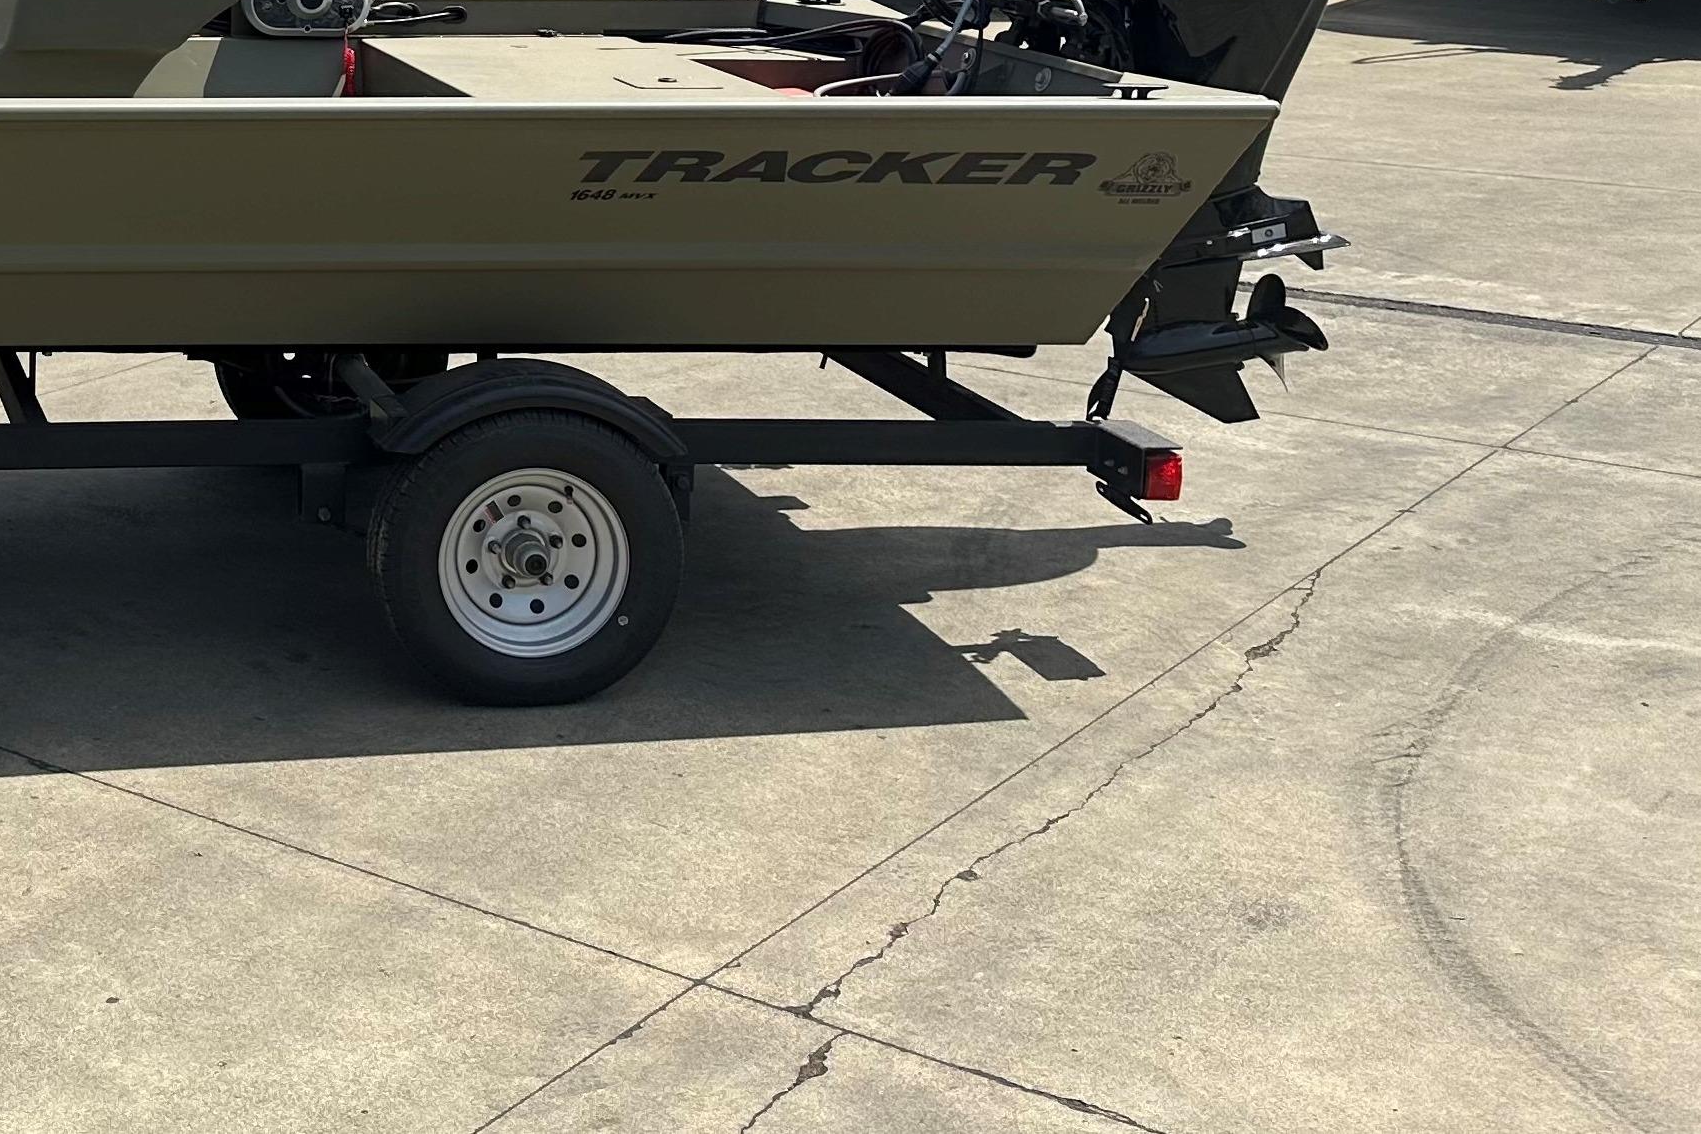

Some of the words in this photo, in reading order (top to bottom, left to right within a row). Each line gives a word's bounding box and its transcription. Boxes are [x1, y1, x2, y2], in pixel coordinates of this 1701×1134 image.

[578, 150, 1098, 186] TRACKER
[570, 188, 617, 201] 1648
[1115, 184, 1174, 194] GRIZZLY
